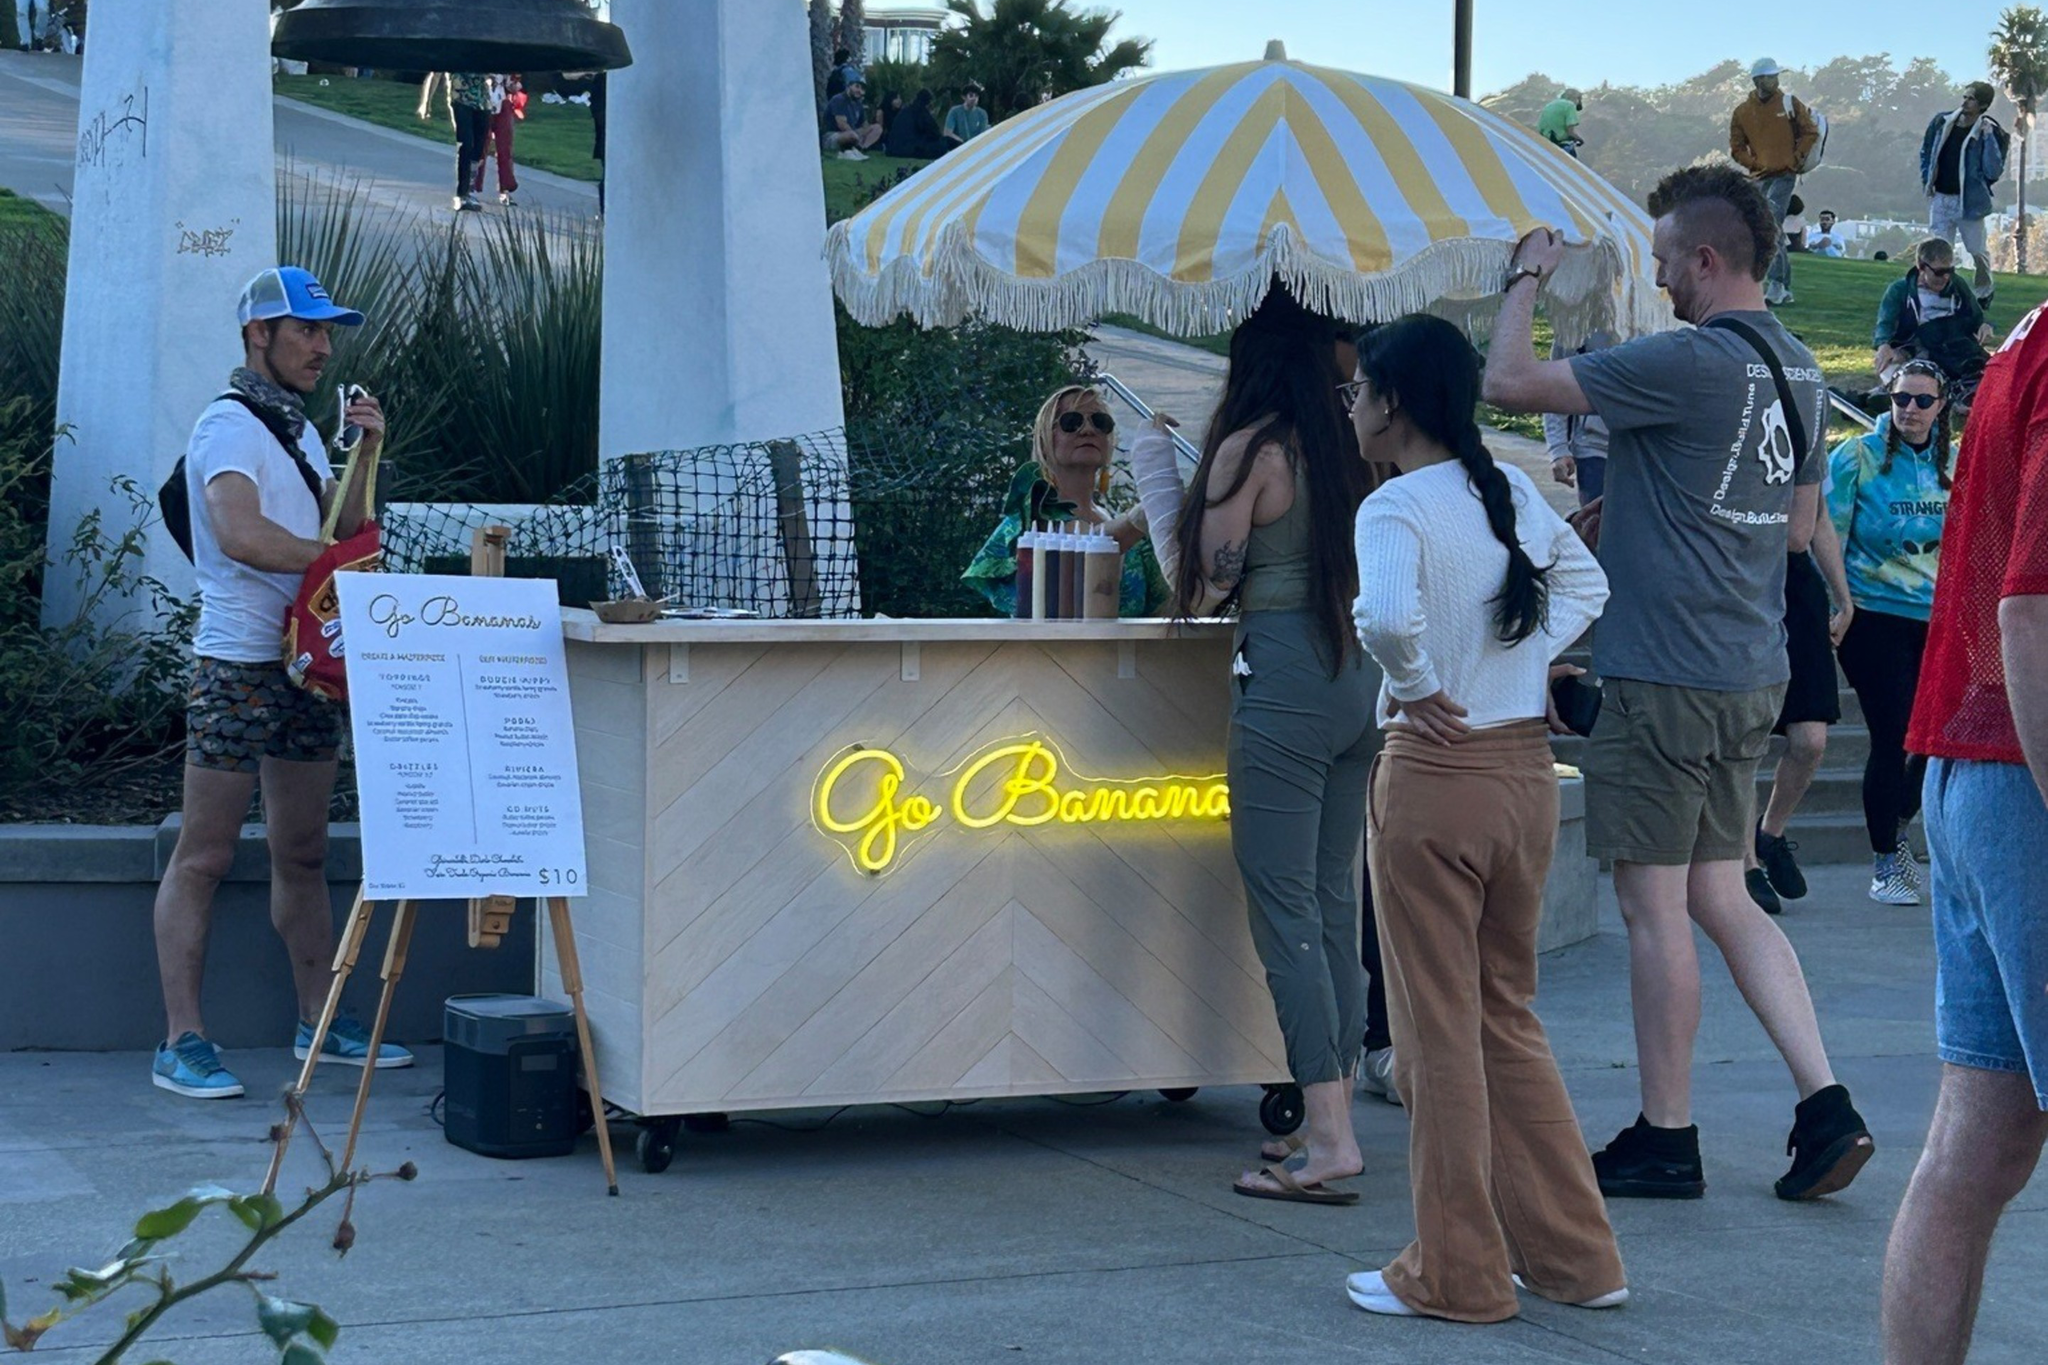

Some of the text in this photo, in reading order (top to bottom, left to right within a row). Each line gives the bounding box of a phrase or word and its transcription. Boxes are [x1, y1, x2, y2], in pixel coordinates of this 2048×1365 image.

[369, 594, 415, 638] Go
[420, 595, 542, 630] Bananas
[820, 741, 1231, 871] Go Banana
[539, 868, 578, 885] $10
